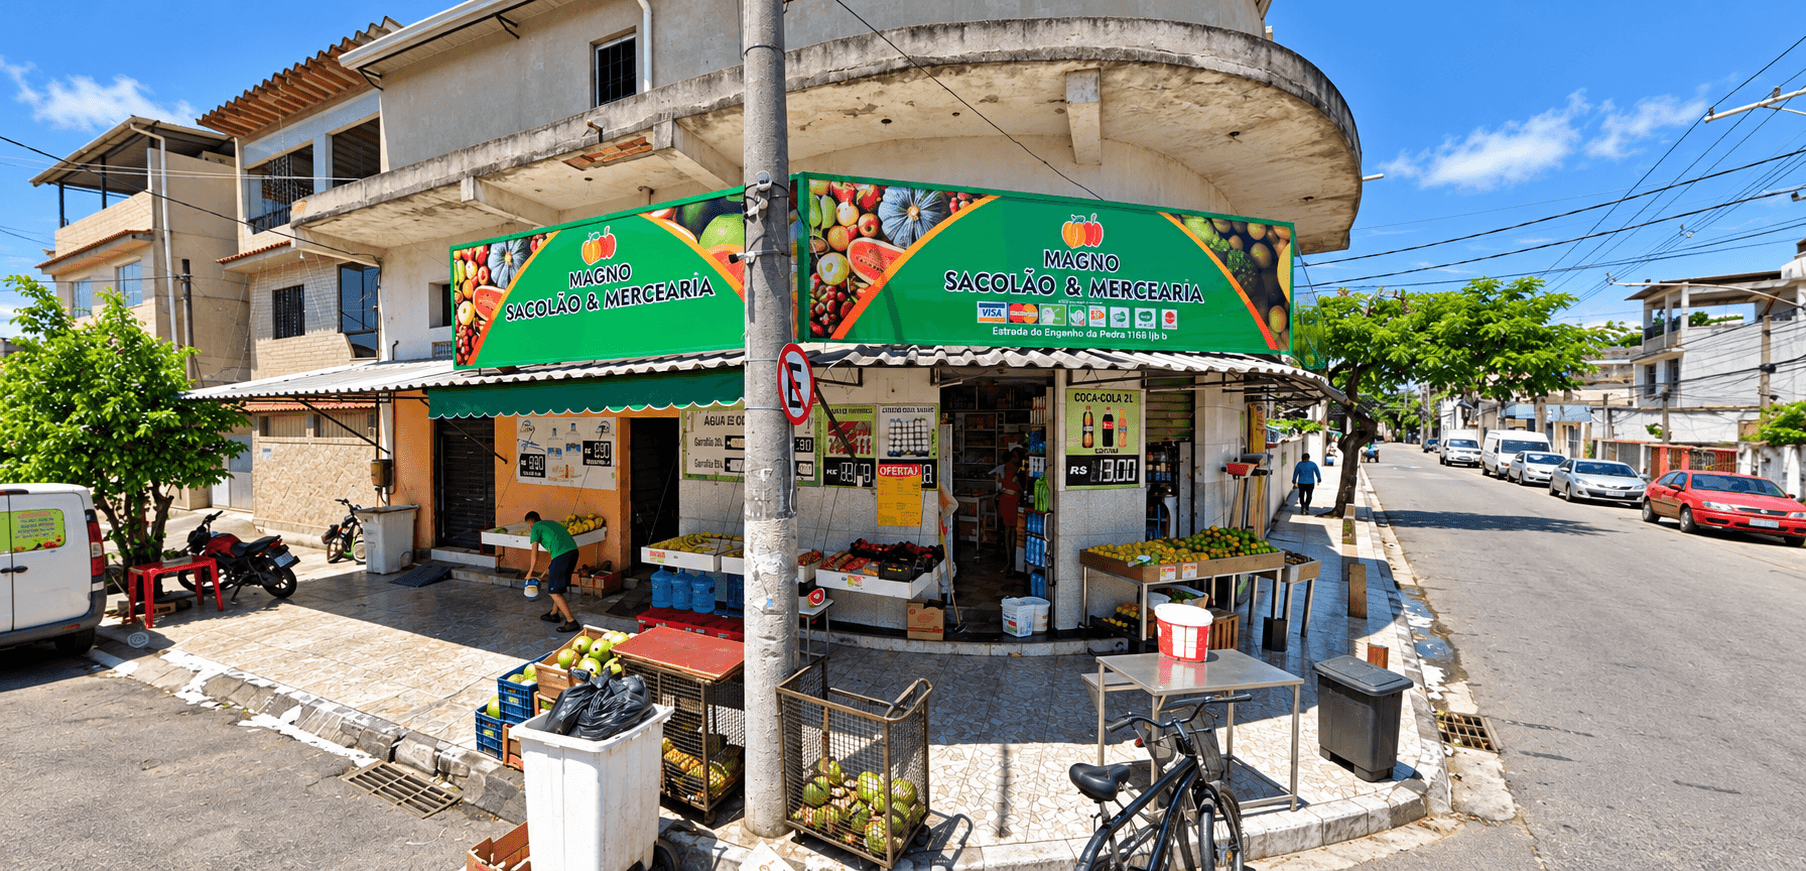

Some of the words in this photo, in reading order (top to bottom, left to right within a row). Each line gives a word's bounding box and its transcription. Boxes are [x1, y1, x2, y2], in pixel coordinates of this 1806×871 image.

[1043, 249, 1120, 272] MAGNO
[569, 263, 632, 289] MAGNO
[943, 268, 1057, 296] SACOLÃO
[1064, 276, 1082, 297] &
[1089, 276, 1205, 304] MERCEARIA
[506, 291, 582, 322] SACOLÃO
[586, 291, 599, 312] &
[603, 274, 716, 309] MERCEARIA
[982, 308, 1003, 317] VISA
[1030, 327, 1042, 336] do
[1099, 330, 1126, 339] Pedra
[787, 362, 802, 408] E
[1074, 392, 1122, 403] COCA-COLA
[1124, 393, 1134, 403] 2L
